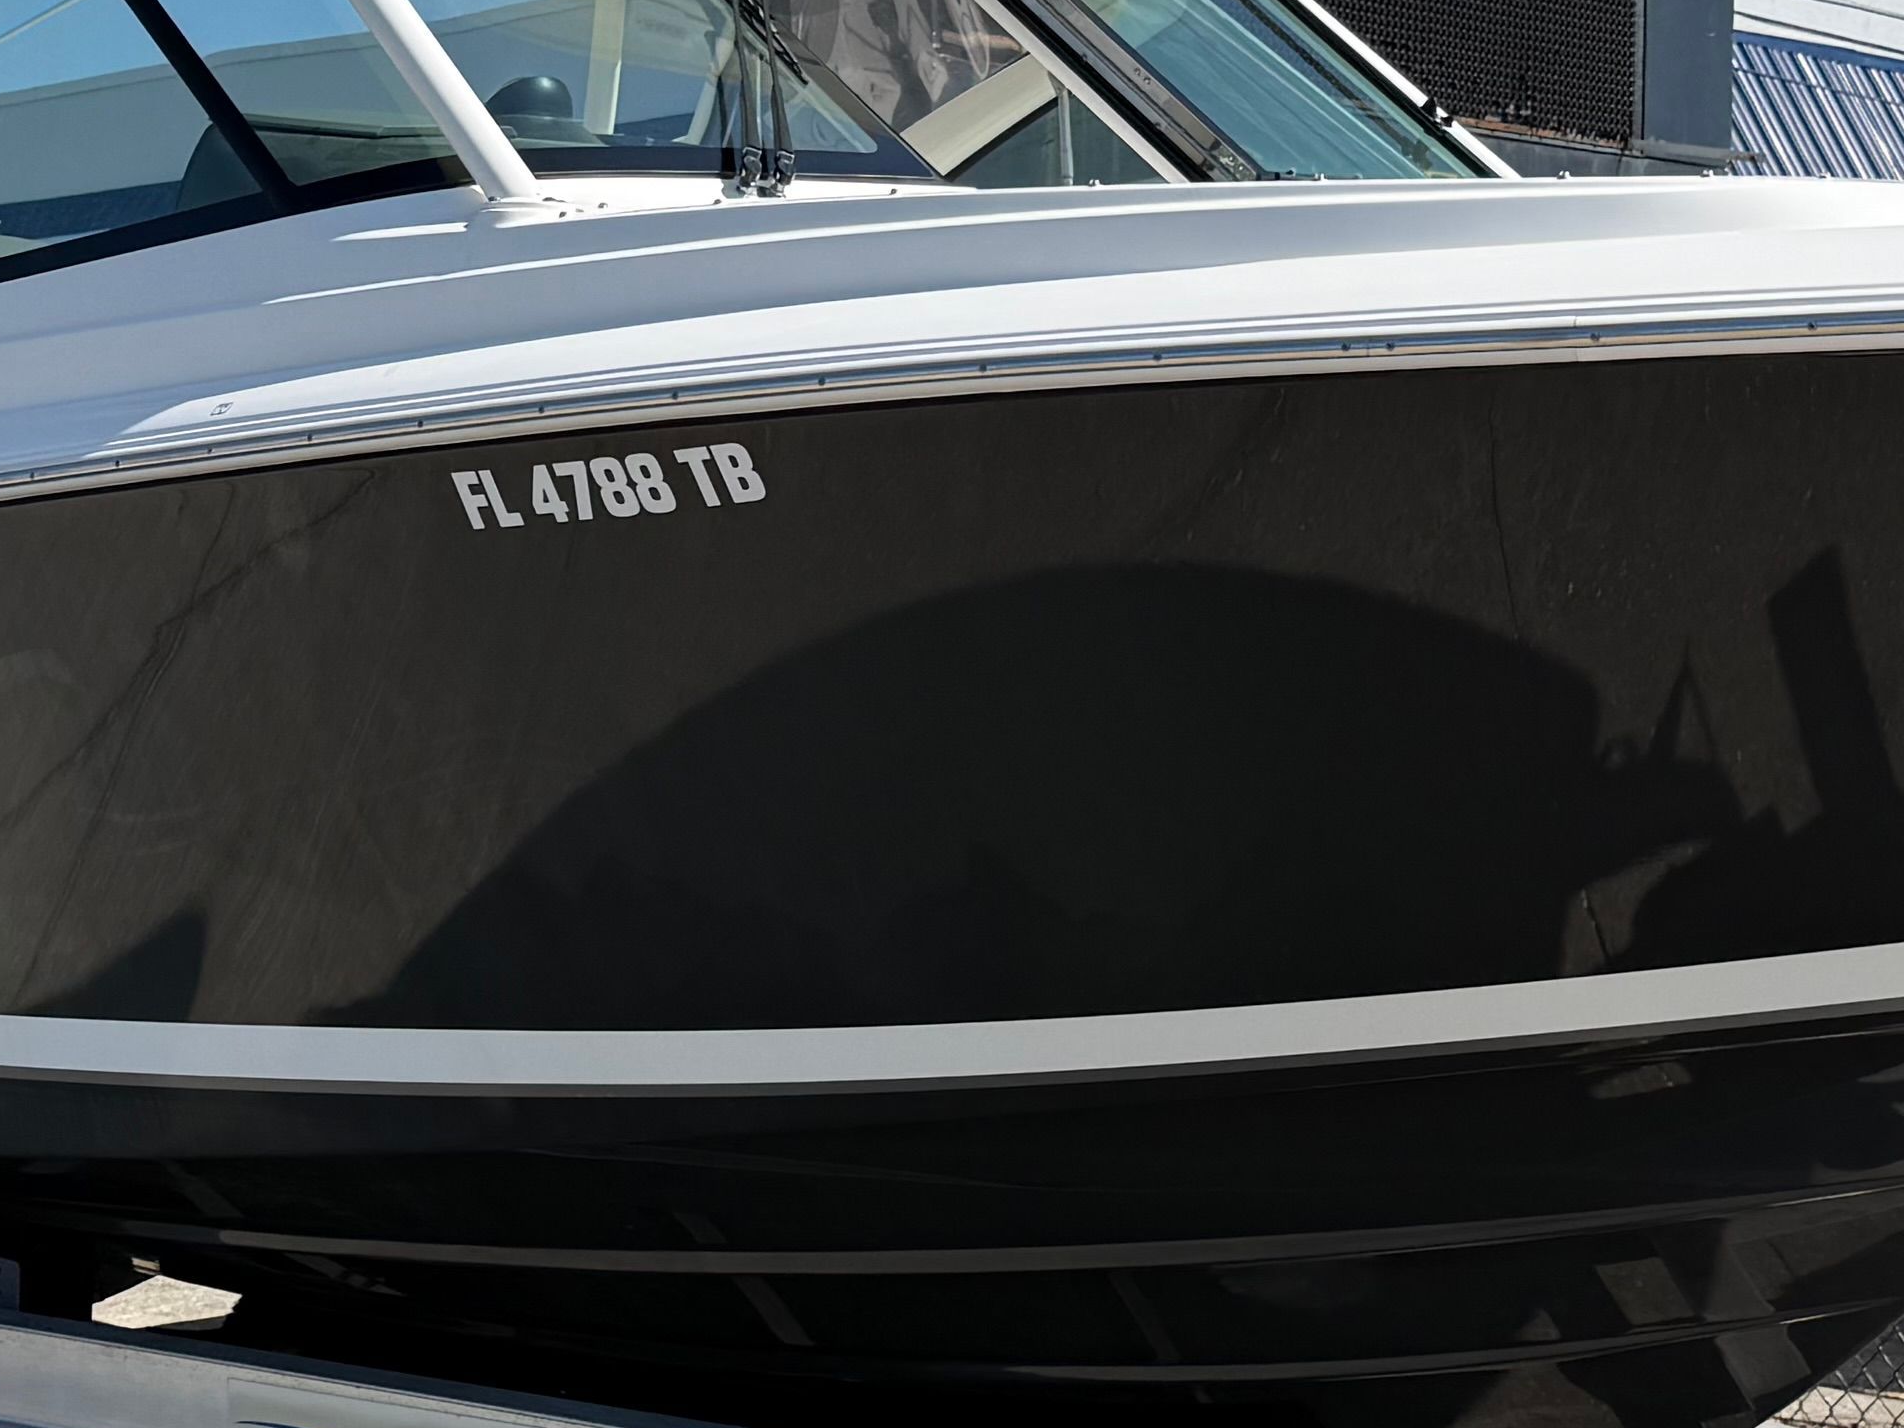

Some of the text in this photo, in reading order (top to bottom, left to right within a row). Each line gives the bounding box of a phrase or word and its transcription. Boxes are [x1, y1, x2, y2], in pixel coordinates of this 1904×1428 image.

[451, 443, 766, 530] FL 4788 TB
